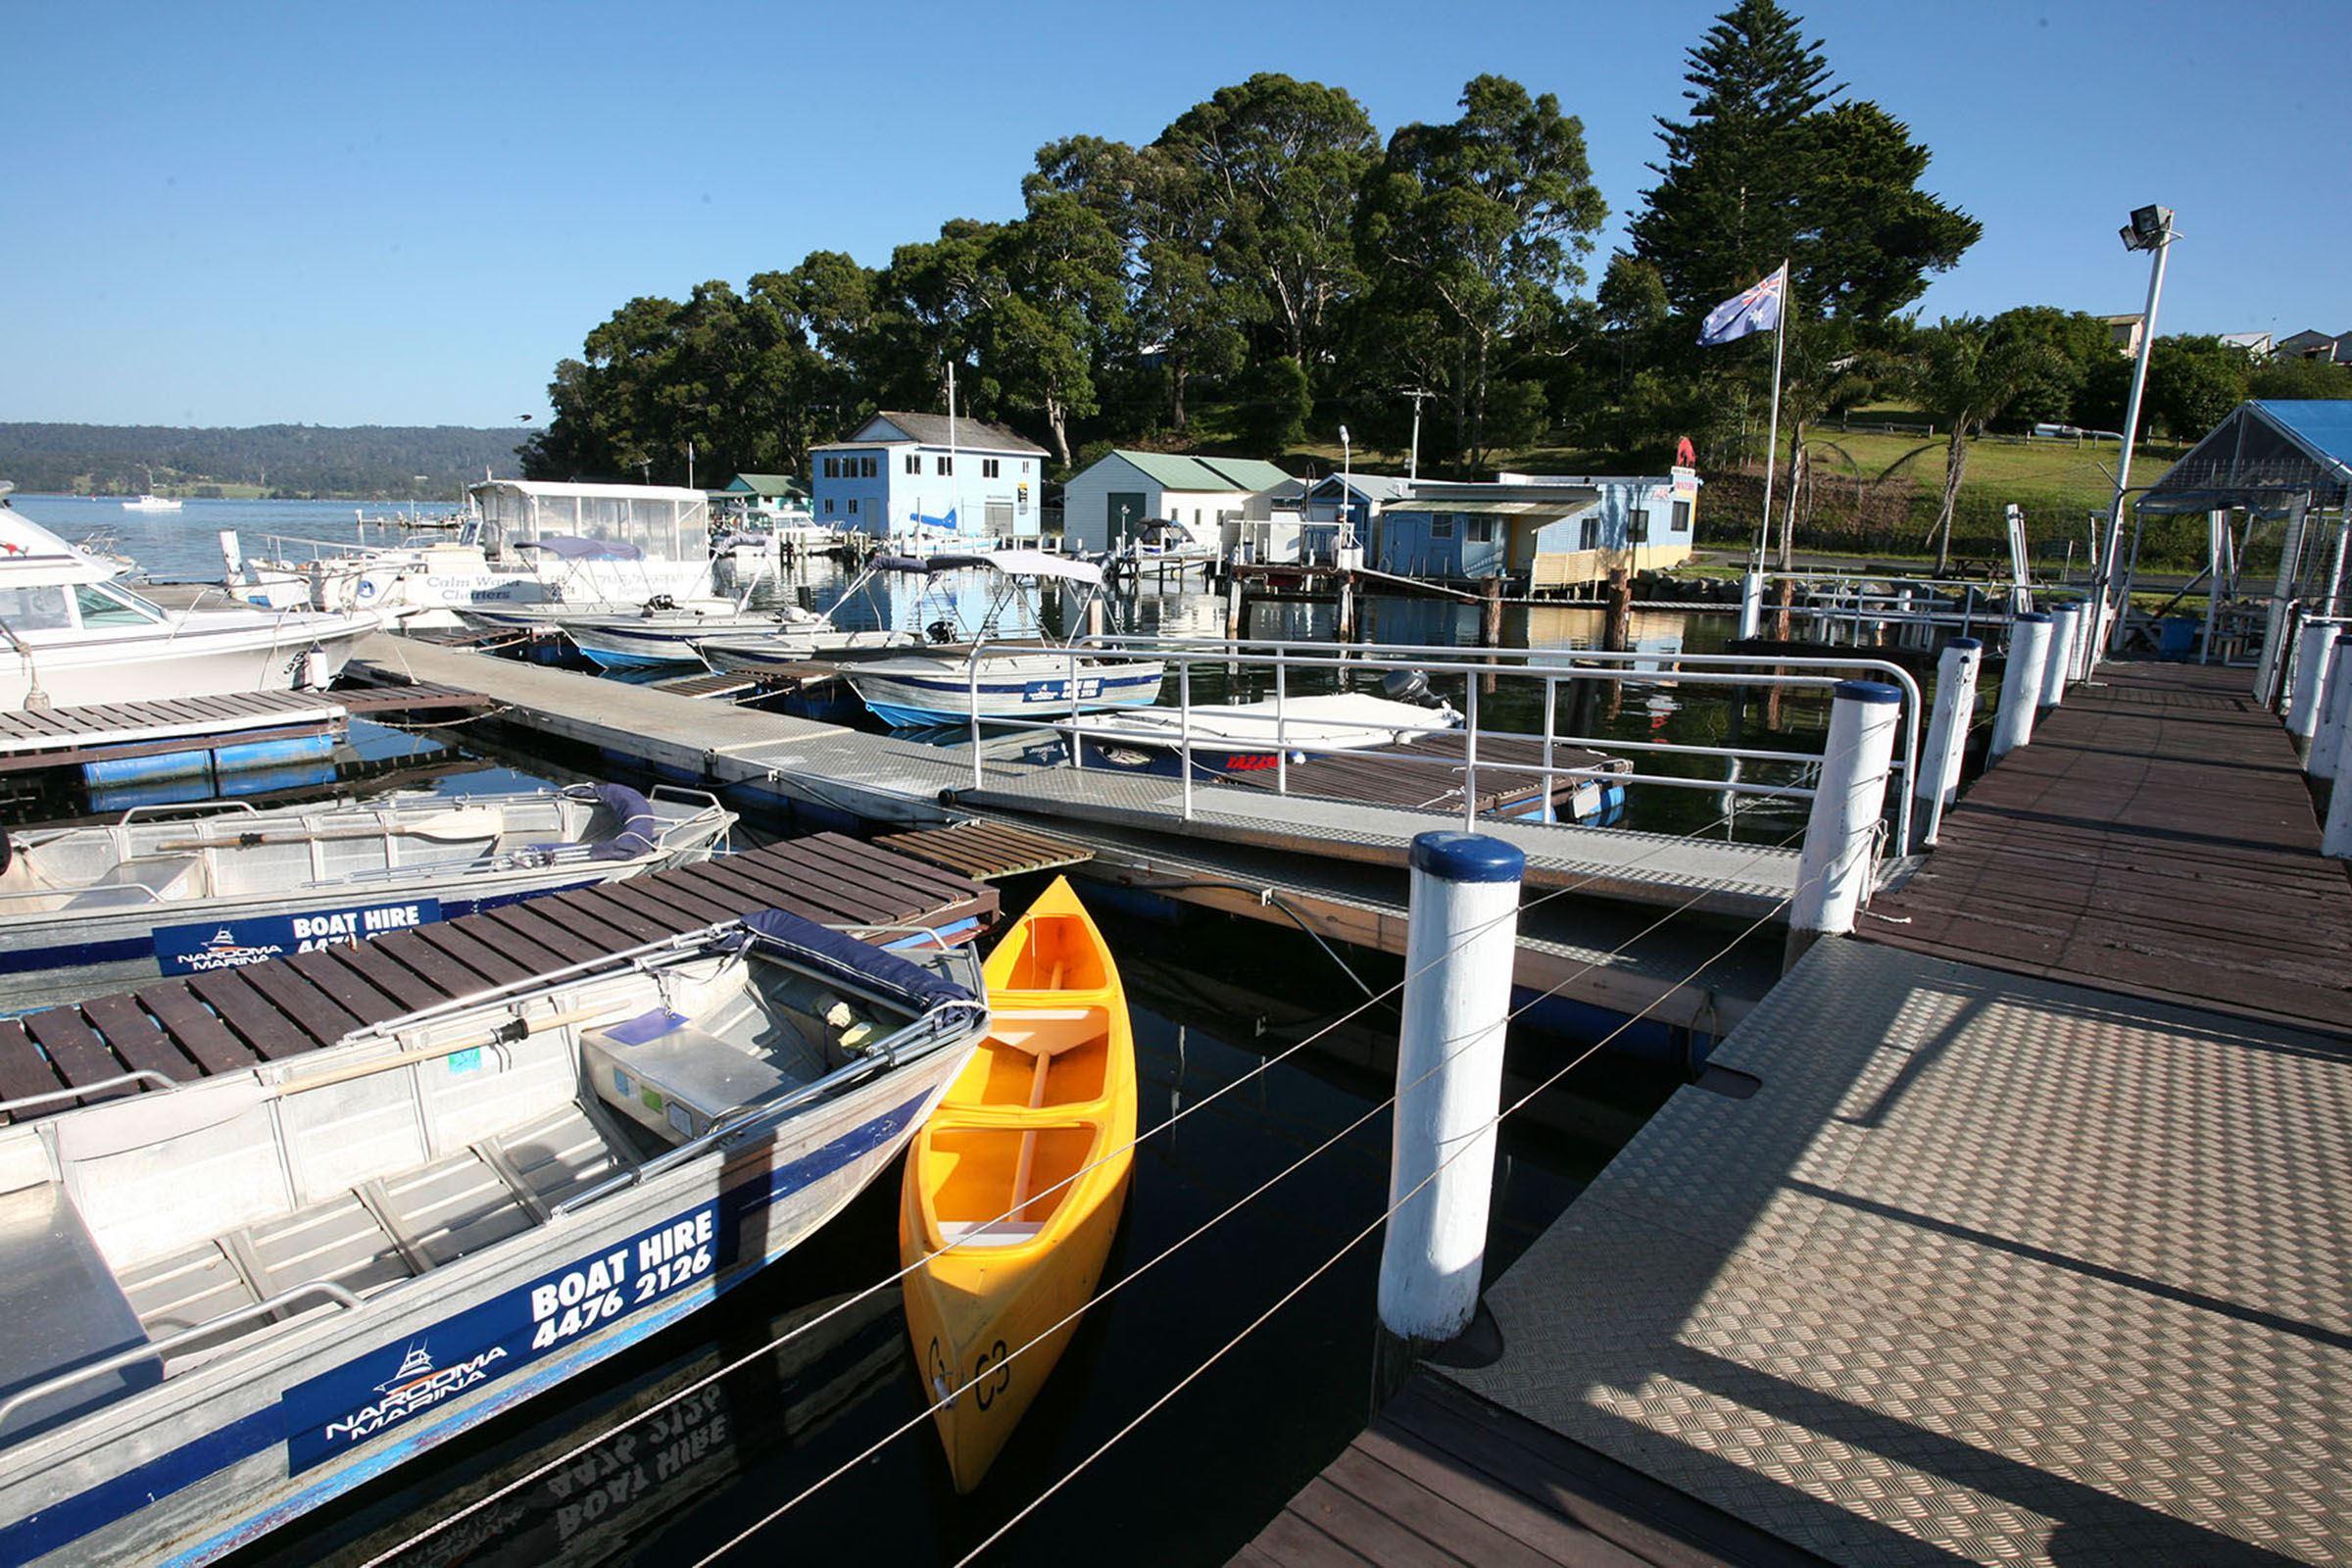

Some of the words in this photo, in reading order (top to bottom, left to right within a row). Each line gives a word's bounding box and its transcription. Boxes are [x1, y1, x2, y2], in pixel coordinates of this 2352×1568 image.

[427, 576, 470, 588] Calm
[177, 945, 283, 964] NAROOMA
[293, 912, 358, 939] BOAT
[364, 906, 420, 931] HIRE
[193, 955, 270, 970] MARINA
[531, 1249, 629, 1323] BOAT
[638, 1209, 713, 1272] HIRE
[532, 1287, 624, 1350] 4476
[633, 1245, 711, 1304] 2126
[325, 1347, 509, 1441] NAROOMA
[351, 1369, 487, 1441] MARINA
[975, 1340, 1010, 1410] C3
